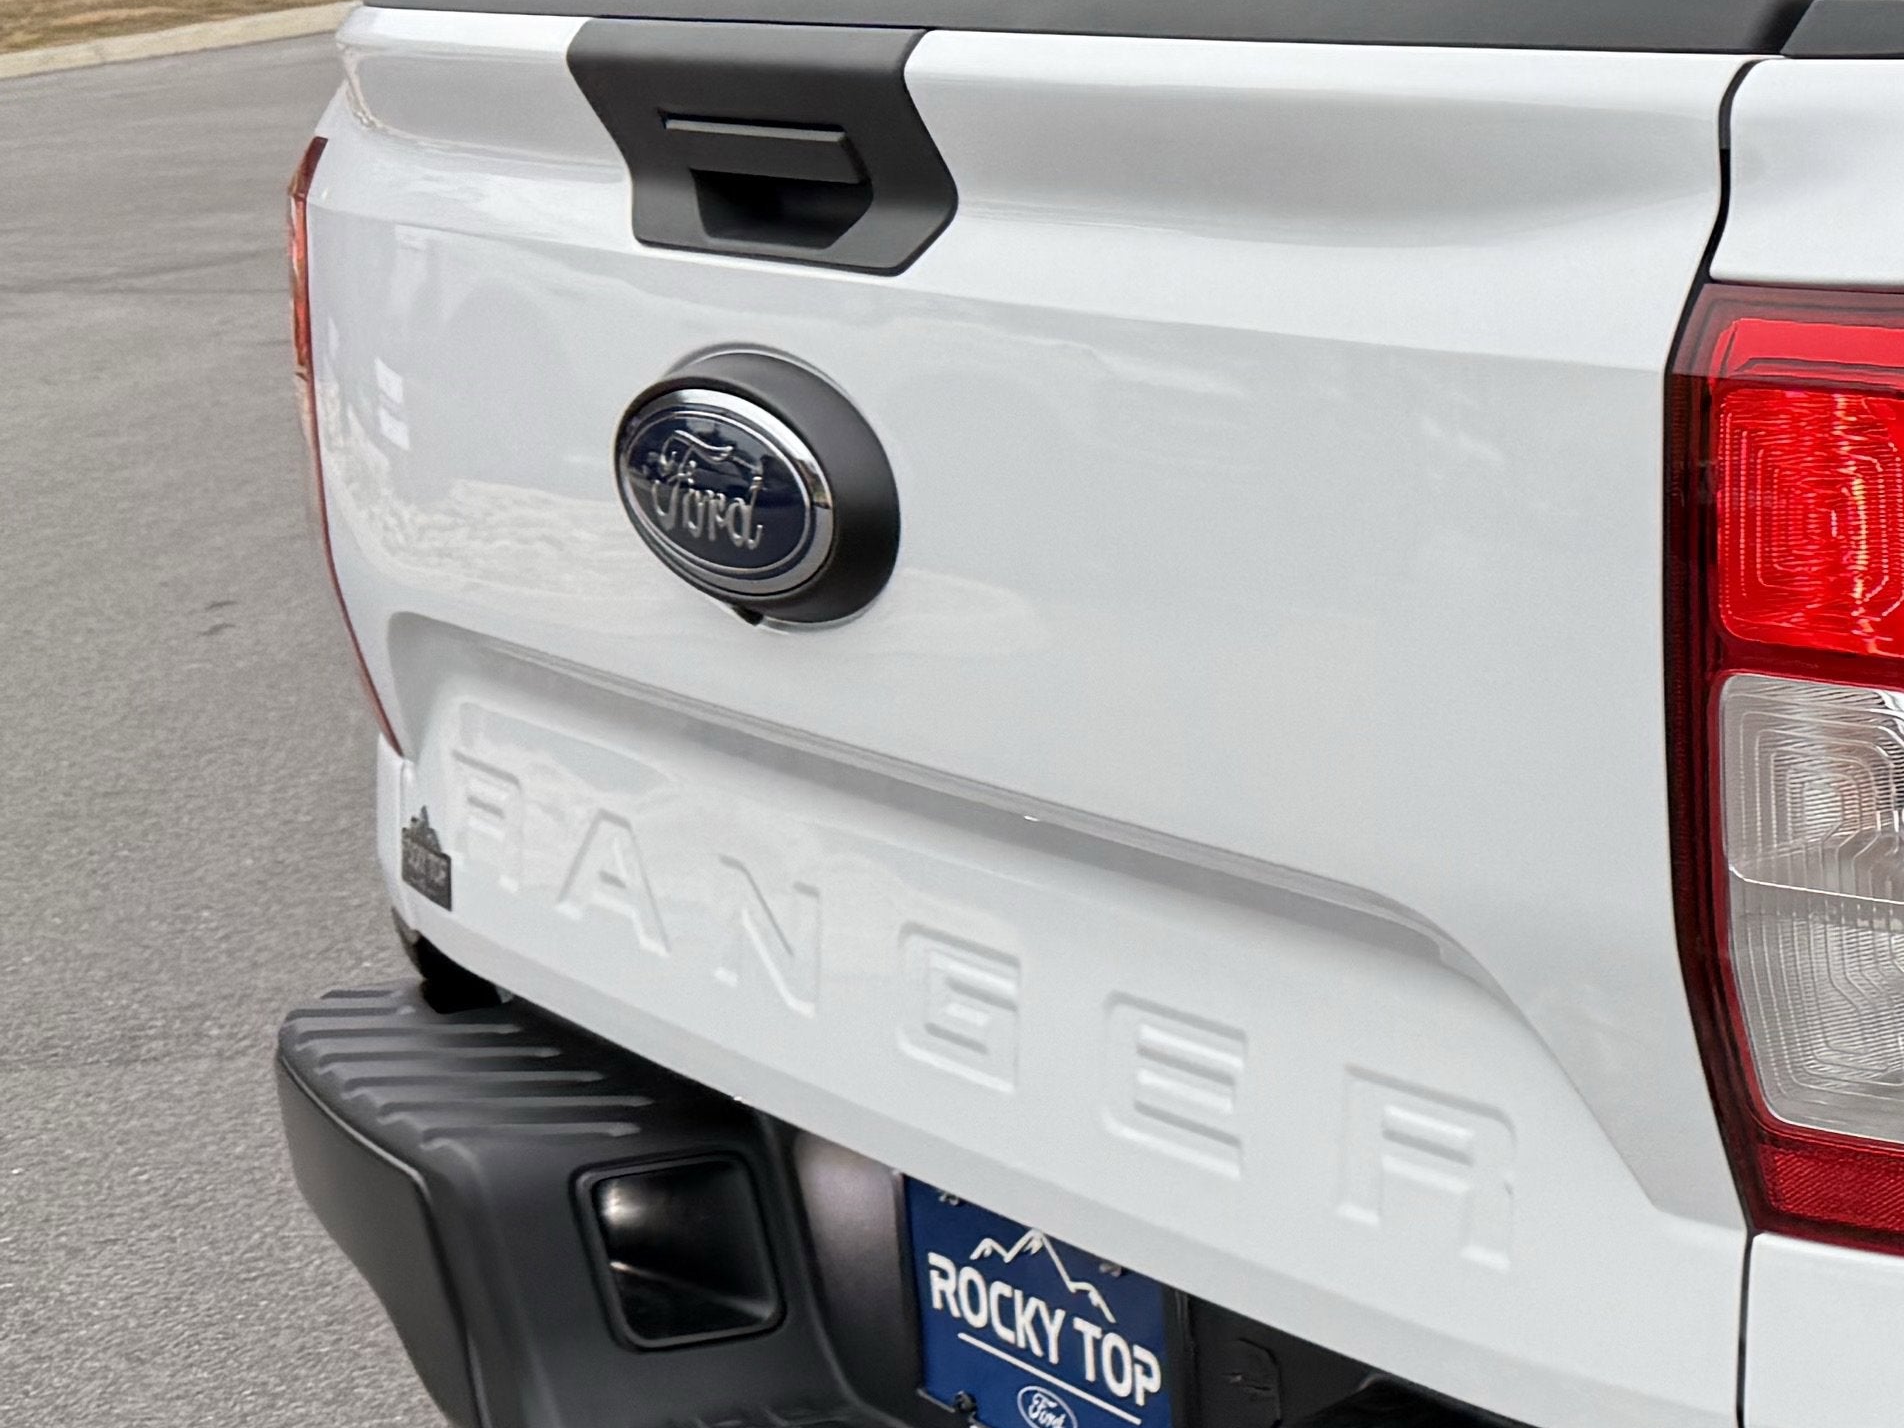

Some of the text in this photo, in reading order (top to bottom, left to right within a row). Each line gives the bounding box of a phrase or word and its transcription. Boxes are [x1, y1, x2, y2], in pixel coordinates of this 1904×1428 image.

[651, 429, 764, 550] Ford
[448, 740, 1516, 1271] RANGER
[927, 1252, 1162, 1406] ROCKY TOP
